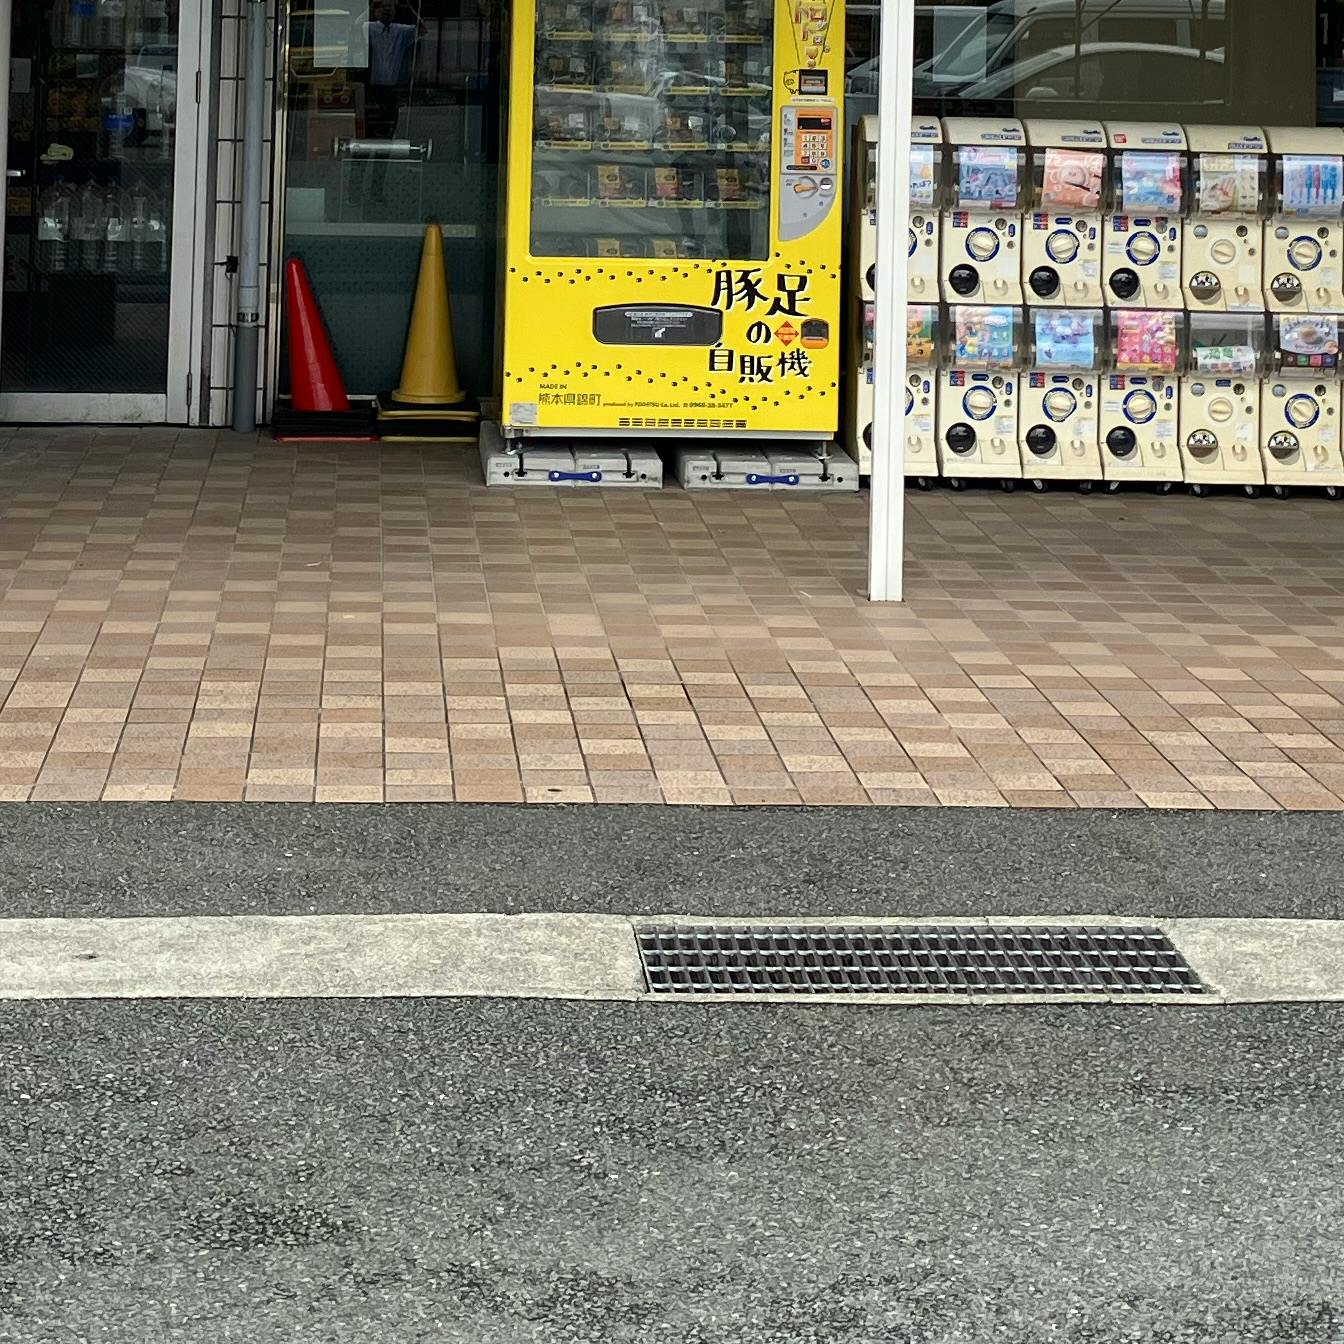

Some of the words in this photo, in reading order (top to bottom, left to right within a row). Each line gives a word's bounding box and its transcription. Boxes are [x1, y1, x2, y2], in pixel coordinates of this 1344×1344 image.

[711, 267, 812, 317] 豚足
[746, 320, 772, 344] の
[708, 342, 813, 383] 自販機
